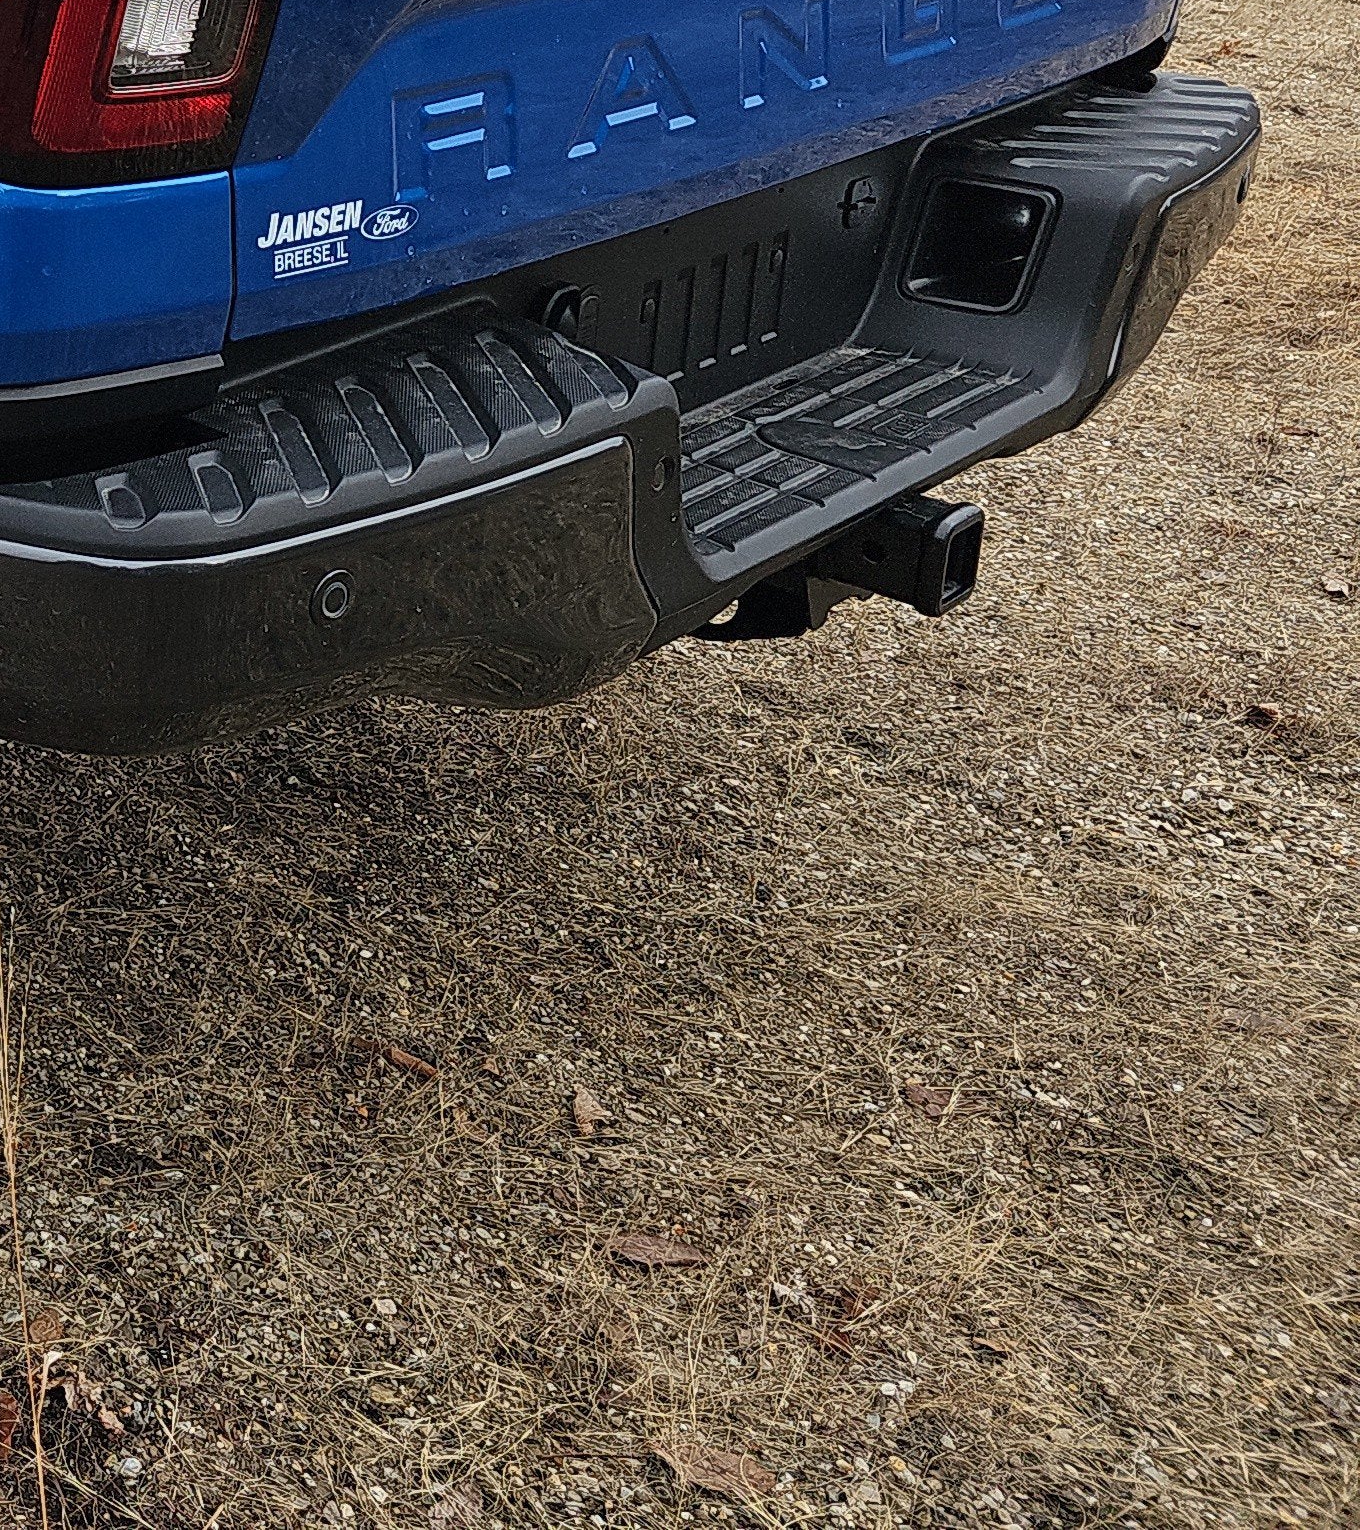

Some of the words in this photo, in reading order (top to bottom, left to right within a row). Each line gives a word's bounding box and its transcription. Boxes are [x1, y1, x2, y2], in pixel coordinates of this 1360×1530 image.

[257, 199, 363, 249] JANSEN
[372, 207, 411, 236] Ford
[274, 245, 335, 273] BREESE,
[336, 240, 349, 260] IL
